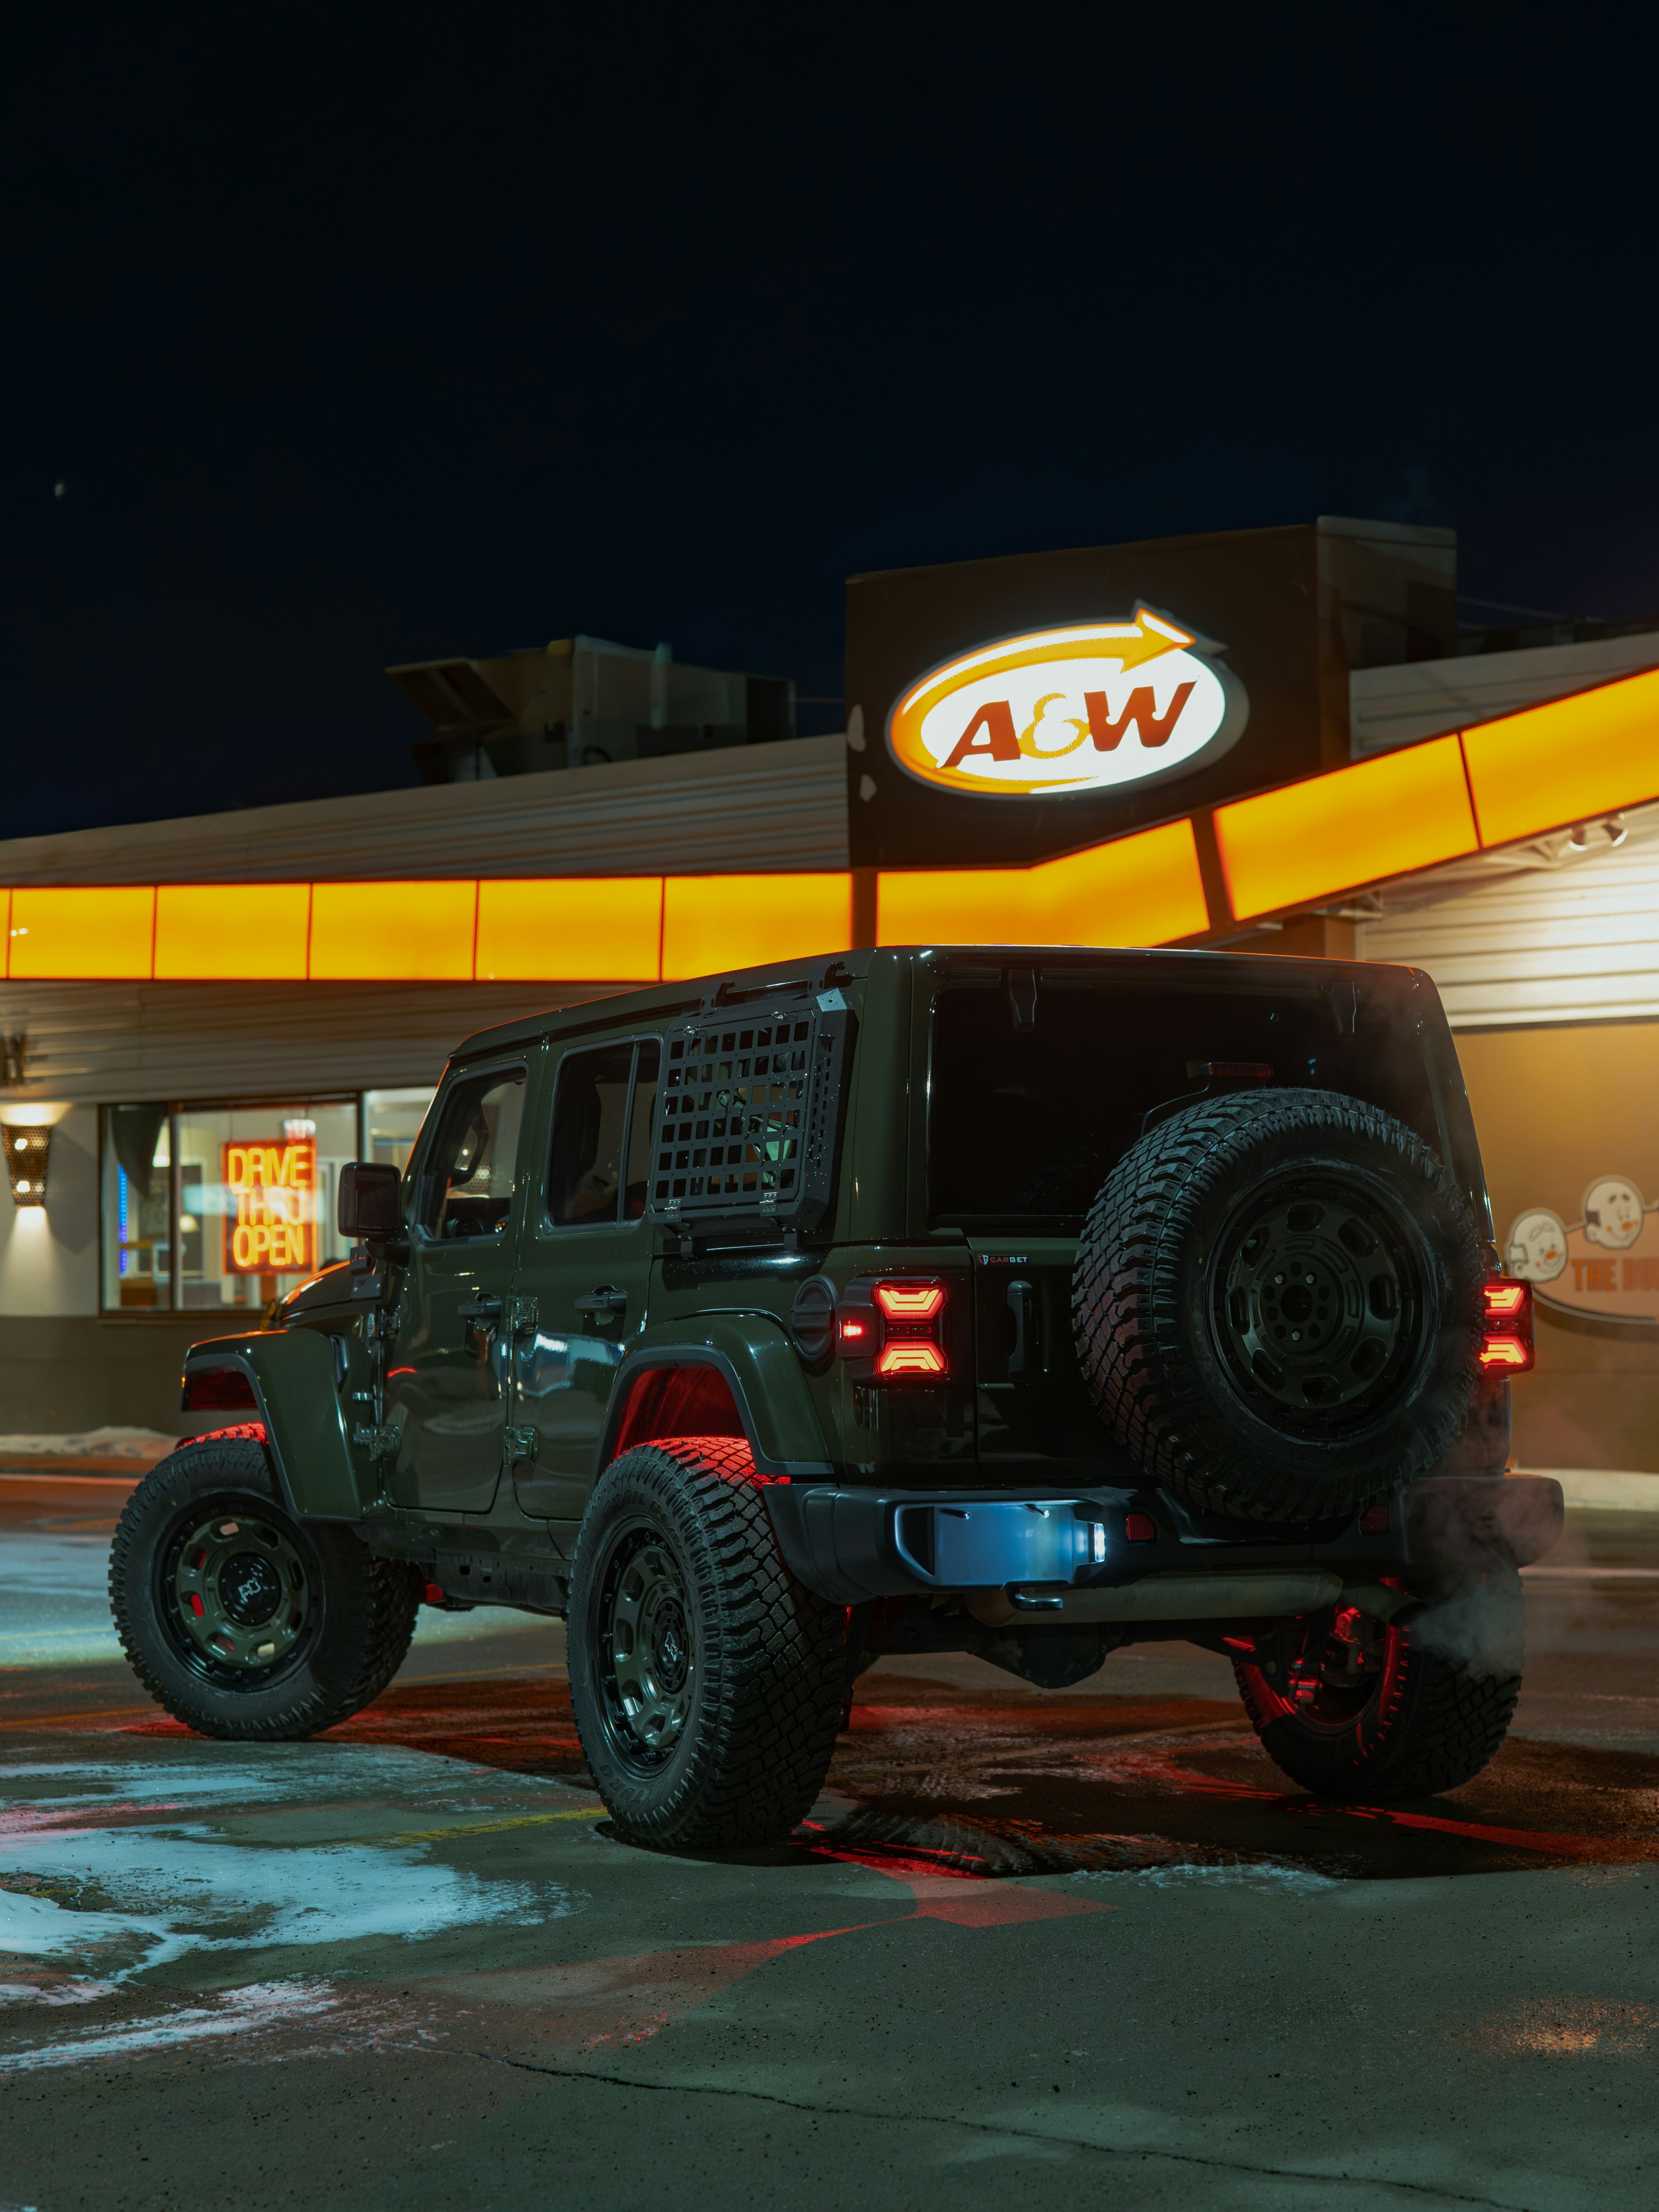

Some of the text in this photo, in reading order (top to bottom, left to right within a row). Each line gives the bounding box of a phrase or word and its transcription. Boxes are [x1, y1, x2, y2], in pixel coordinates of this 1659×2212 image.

[936, 680, 1200, 768] A&W
[228, 1146, 308, 1188] DRIVE
[231, 1184, 307, 1226] THRU
[233, 1224, 304, 1267] OPEN
[1572, 1259, 1659, 1291] THE BU
